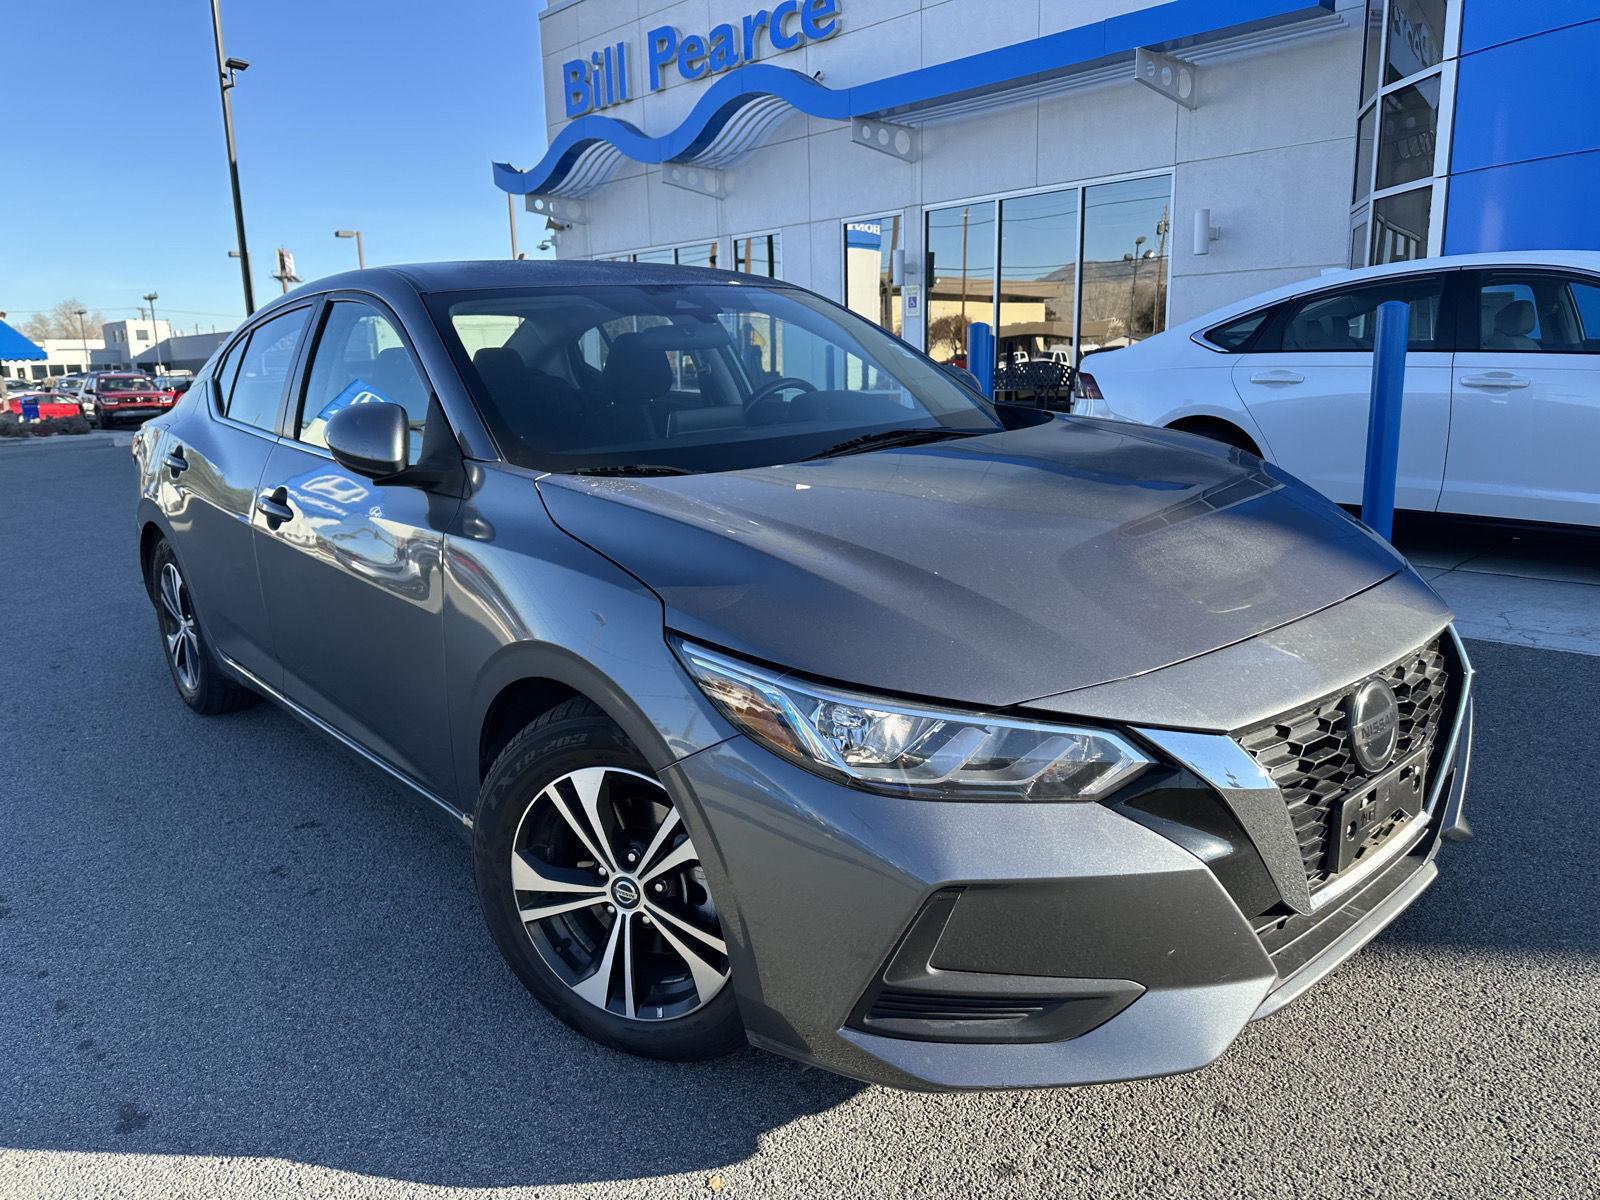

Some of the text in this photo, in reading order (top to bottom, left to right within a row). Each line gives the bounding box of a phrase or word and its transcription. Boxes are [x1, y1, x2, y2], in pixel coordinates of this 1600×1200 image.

[563, 0, 841, 118] Bill Pearce
[1361, 709, 1395, 739] NISSAN
